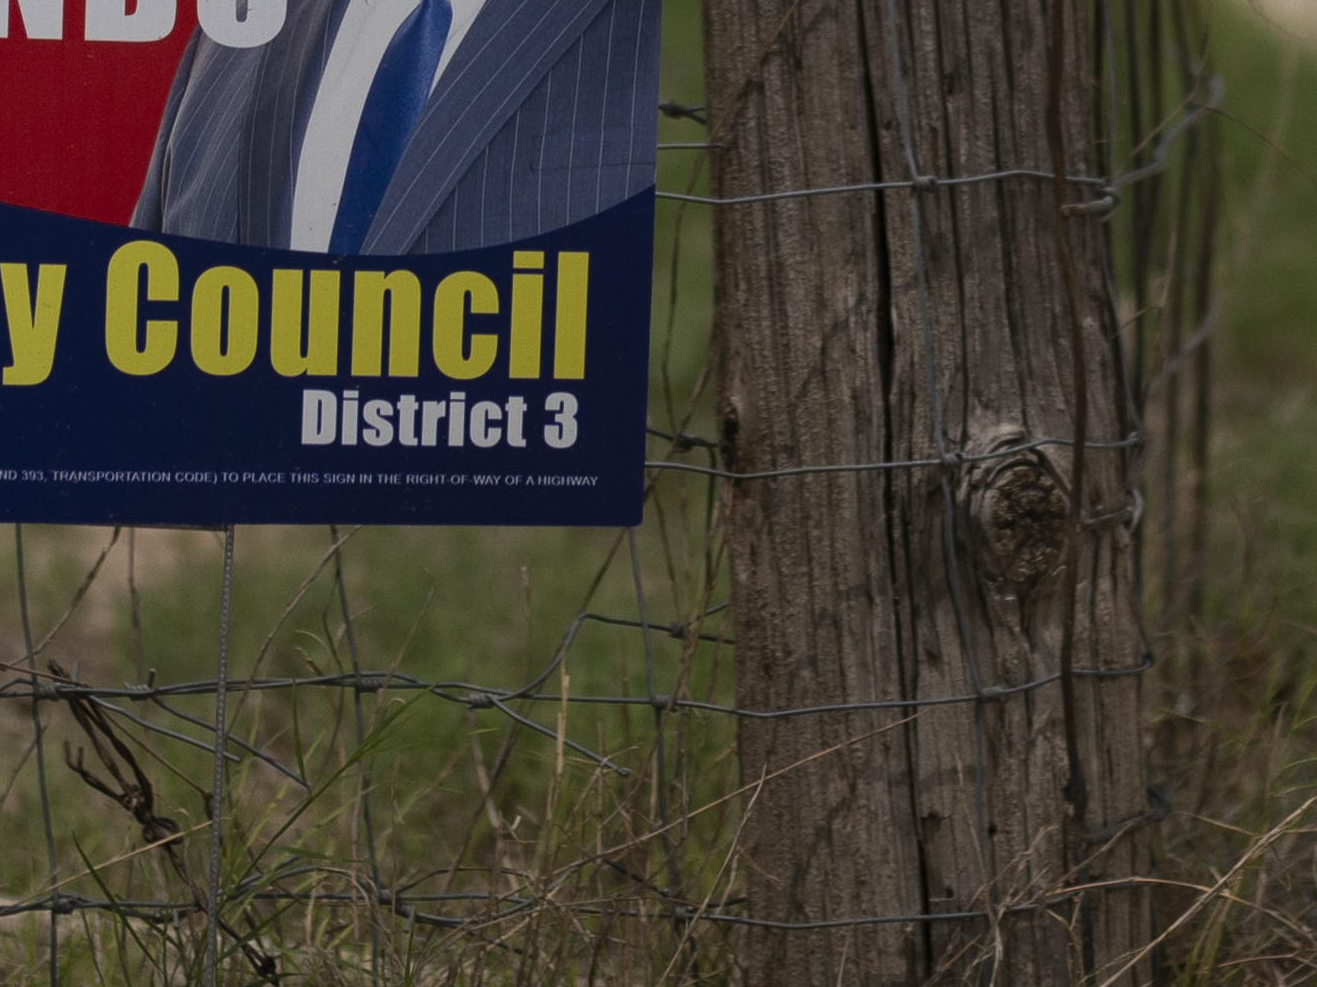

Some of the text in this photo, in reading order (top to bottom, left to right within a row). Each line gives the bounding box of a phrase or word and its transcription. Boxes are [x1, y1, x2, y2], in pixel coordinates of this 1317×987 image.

[105, 240, 590, 380] Council
[302, 390, 577, 448] District 3
[21, 469, 47, 483] 393,
[52, 470, 171, 484] TRANSPORTATION
[174, 471, 218, 485] CODE)
[222, 471, 239, 483] TO
[242, 471, 286, 484] PLACE
[289, 472, 320, 484] THIS
[323, 472, 356, 484] SIGN
[359, 473, 373, 484] IN
[376, 473, 402, 485] THE
[504, 474, 523, 486] OF
[525, 474, 535, 486] A
[537, 475, 599, 487] HIGHWAY
